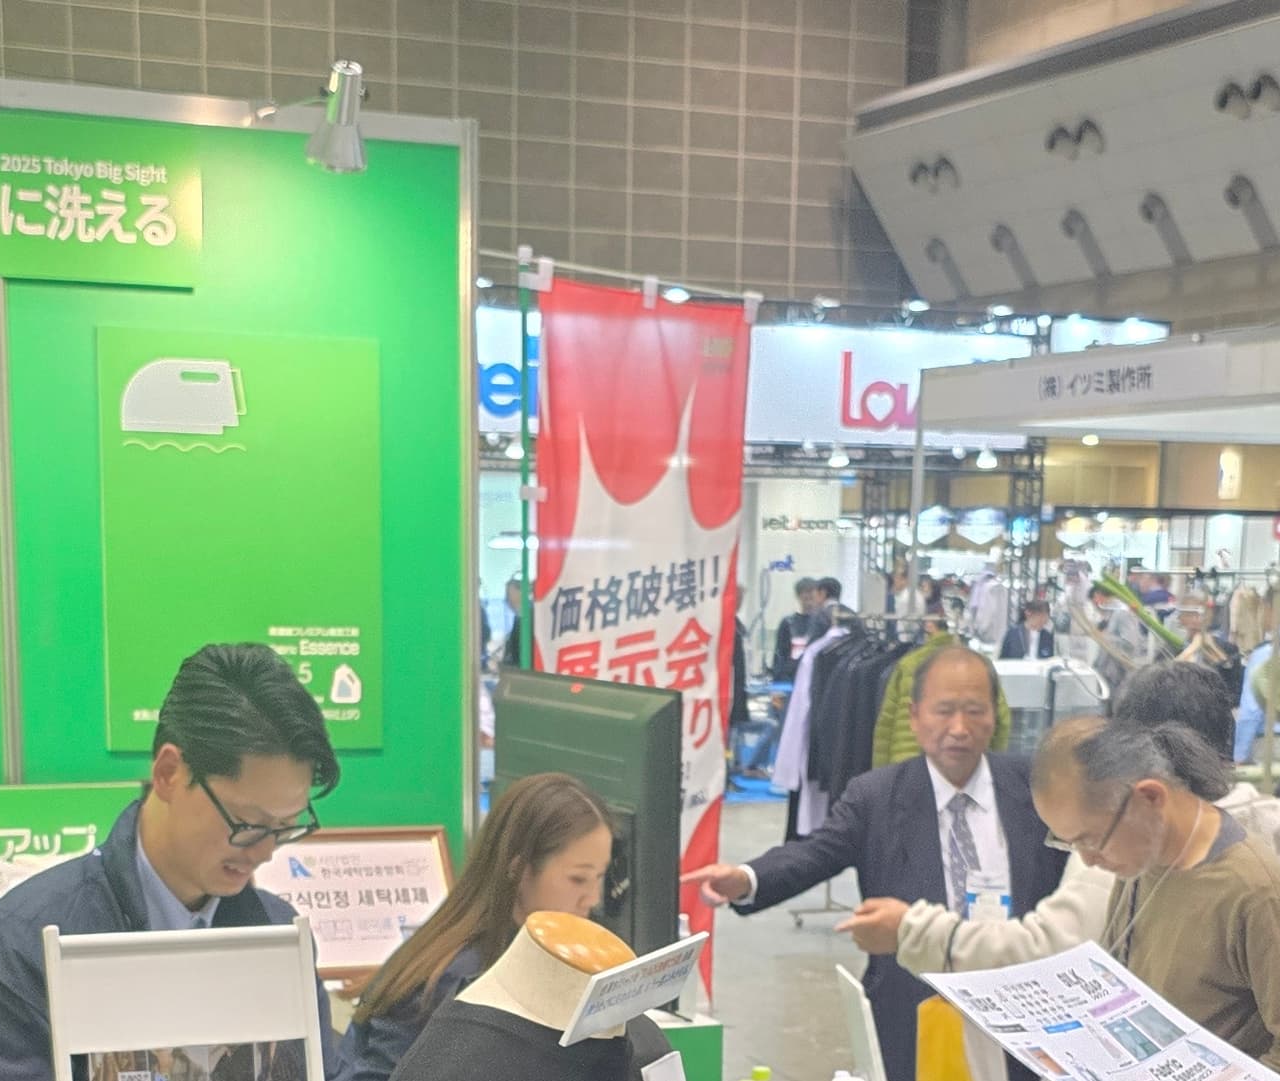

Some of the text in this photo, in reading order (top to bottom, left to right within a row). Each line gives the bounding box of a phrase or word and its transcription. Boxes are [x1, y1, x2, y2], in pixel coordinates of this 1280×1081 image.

[0, 154, 41, 174] 2025
[43, 156, 95, 180] Tokyo
[96, 160, 123, 184] Big
[125, 163, 168, 186] Sight
[550, 556, 721, 641] 価格破壊!!
[298, 639, 360, 656] Essence
[556, 616, 712, 691] 展示会
[297, 662, 312, 684] 5
[358, 887, 430, 906] 세탁세제
